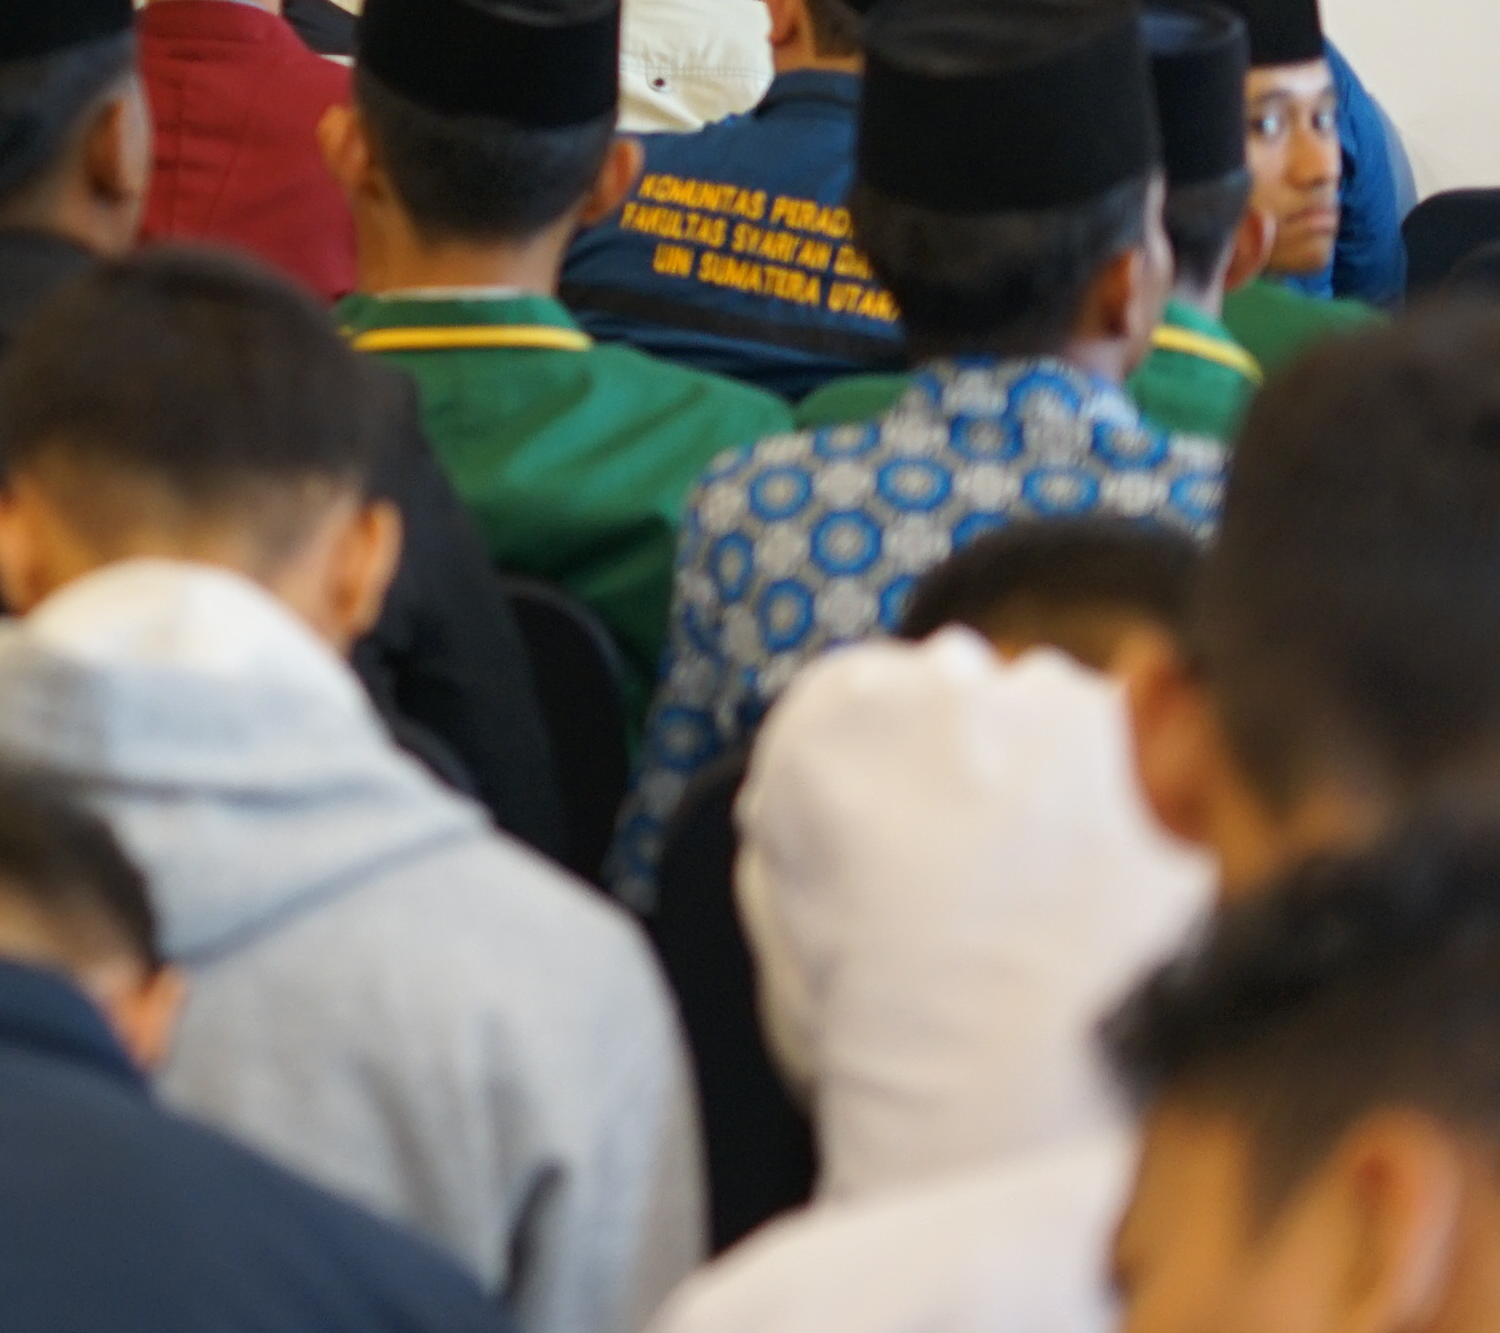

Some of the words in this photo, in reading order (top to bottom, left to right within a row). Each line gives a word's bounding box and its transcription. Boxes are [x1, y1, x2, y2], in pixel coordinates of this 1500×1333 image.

[620, 201, 728, 249] FAKULTAS
[638, 173, 767, 221] KOMUNITAS
[770, 194, 852, 239] PERAD
[697, 250, 821, 307] SUMATERA
